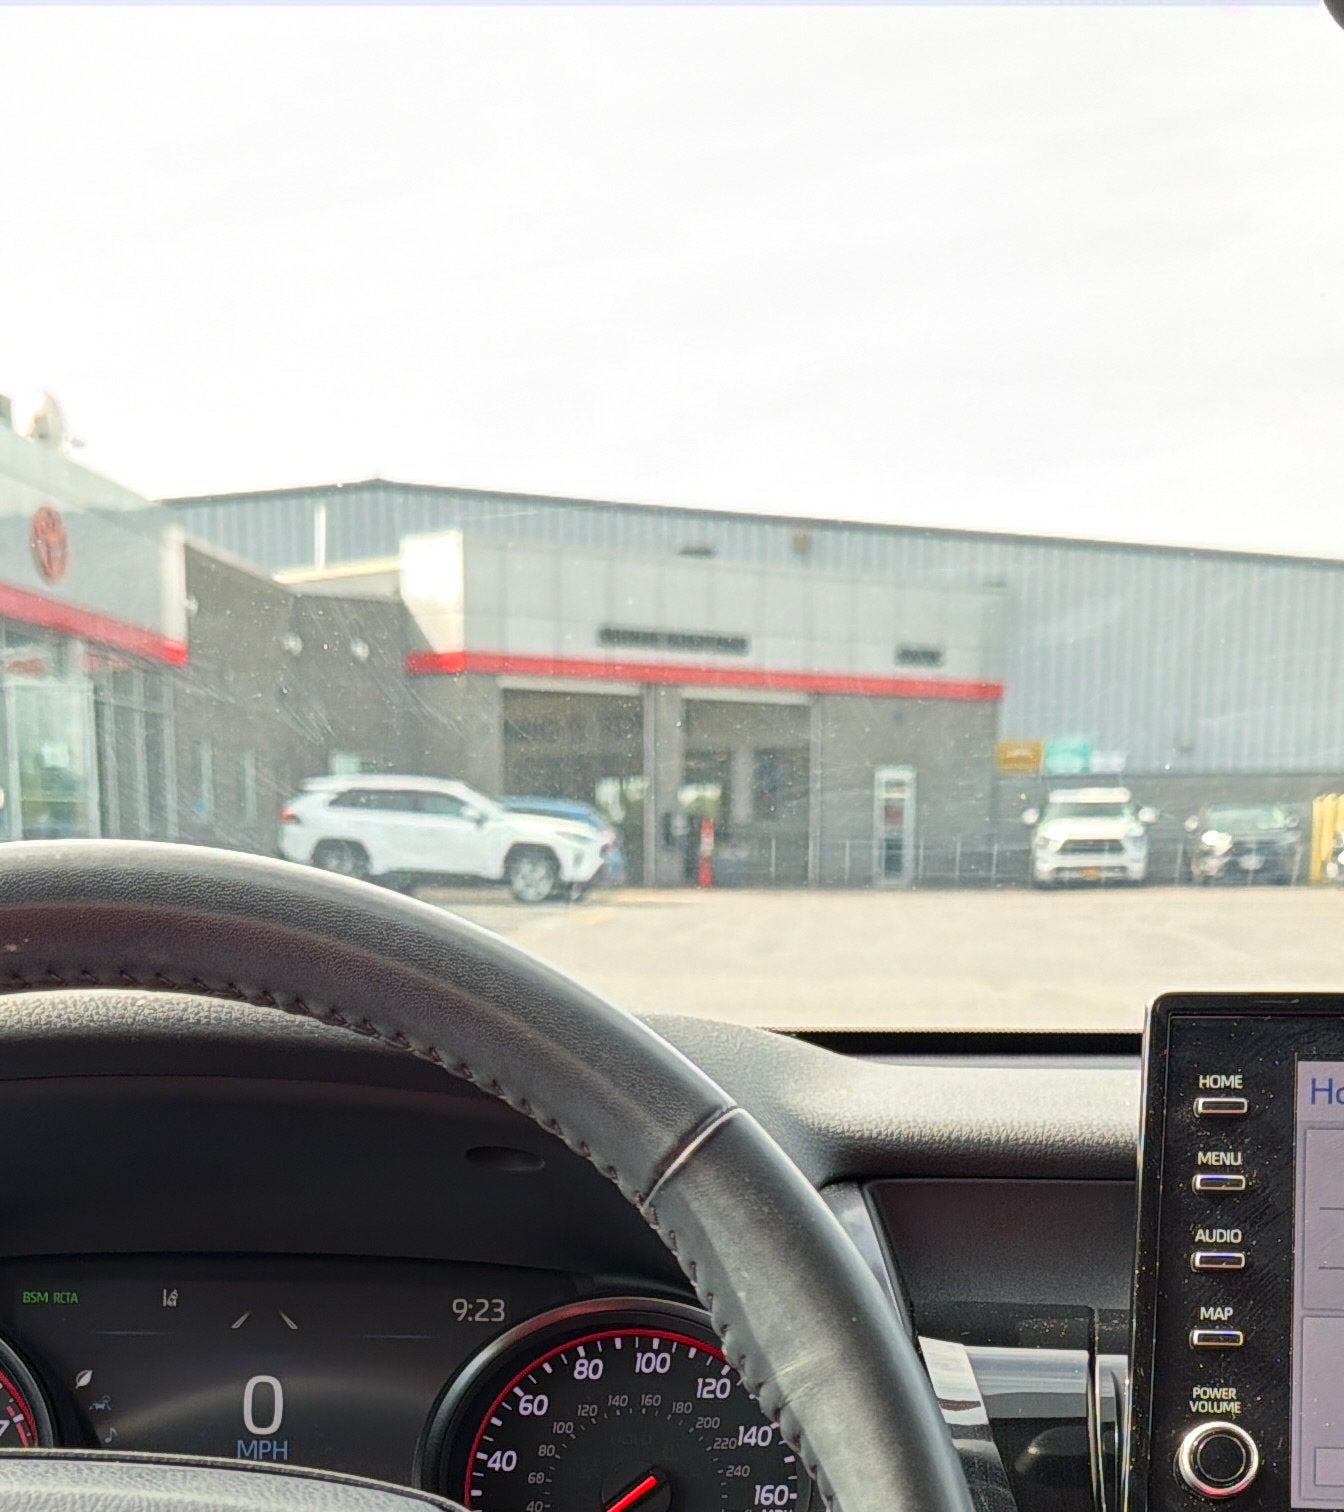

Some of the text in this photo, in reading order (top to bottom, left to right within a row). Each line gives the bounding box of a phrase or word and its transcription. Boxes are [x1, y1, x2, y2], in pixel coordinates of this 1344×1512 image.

[1199, 1074, 1244, 1089] HOME
[1197, 1151, 1243, 1166] MENU
[1194, 1228, 1243, 1243] AUDIO
[22, 1291, 79, 1304] BSM RCTA
[452, 1299, 506, 1323] 9:23
[1199, 1306, 1234, 1321] MAP
[573, 1358, 604, 1380] 80
[635, 1352, 672, 1374] 100
[696, 1377, 731, 1400] 120
[1192, 1387, 1237, 1400] POWER
[243, 1374, 285, 1436] 0
[518, 1394, 549, 1416] 60
[607, 1394, 629, 1407] 140
[640, 1394, 662, 1407] 160
[1189, 1401, 1242, 1414] VOLUME
[577, 1404, 598, 1417] 120
[671, 1402, 692, 1415] 180
[553, 1421, 574, 1435] 100
[695, 1416, 721, 1430] 200
[738, 1425, 774, 1448] 140
[236, 1440, 289, 1461] MPH
[538, 1444, 555, 1457] 80
[713, 1437, 737, 1451] 220
[487, 1450, 517, 1472] 40
[527, 1472, 545, 1485] 60
[725, 1465, 750, 1478] 240
[753, 1484, 789, 1506] 160
[526, 1500, 544, 1512] 40
